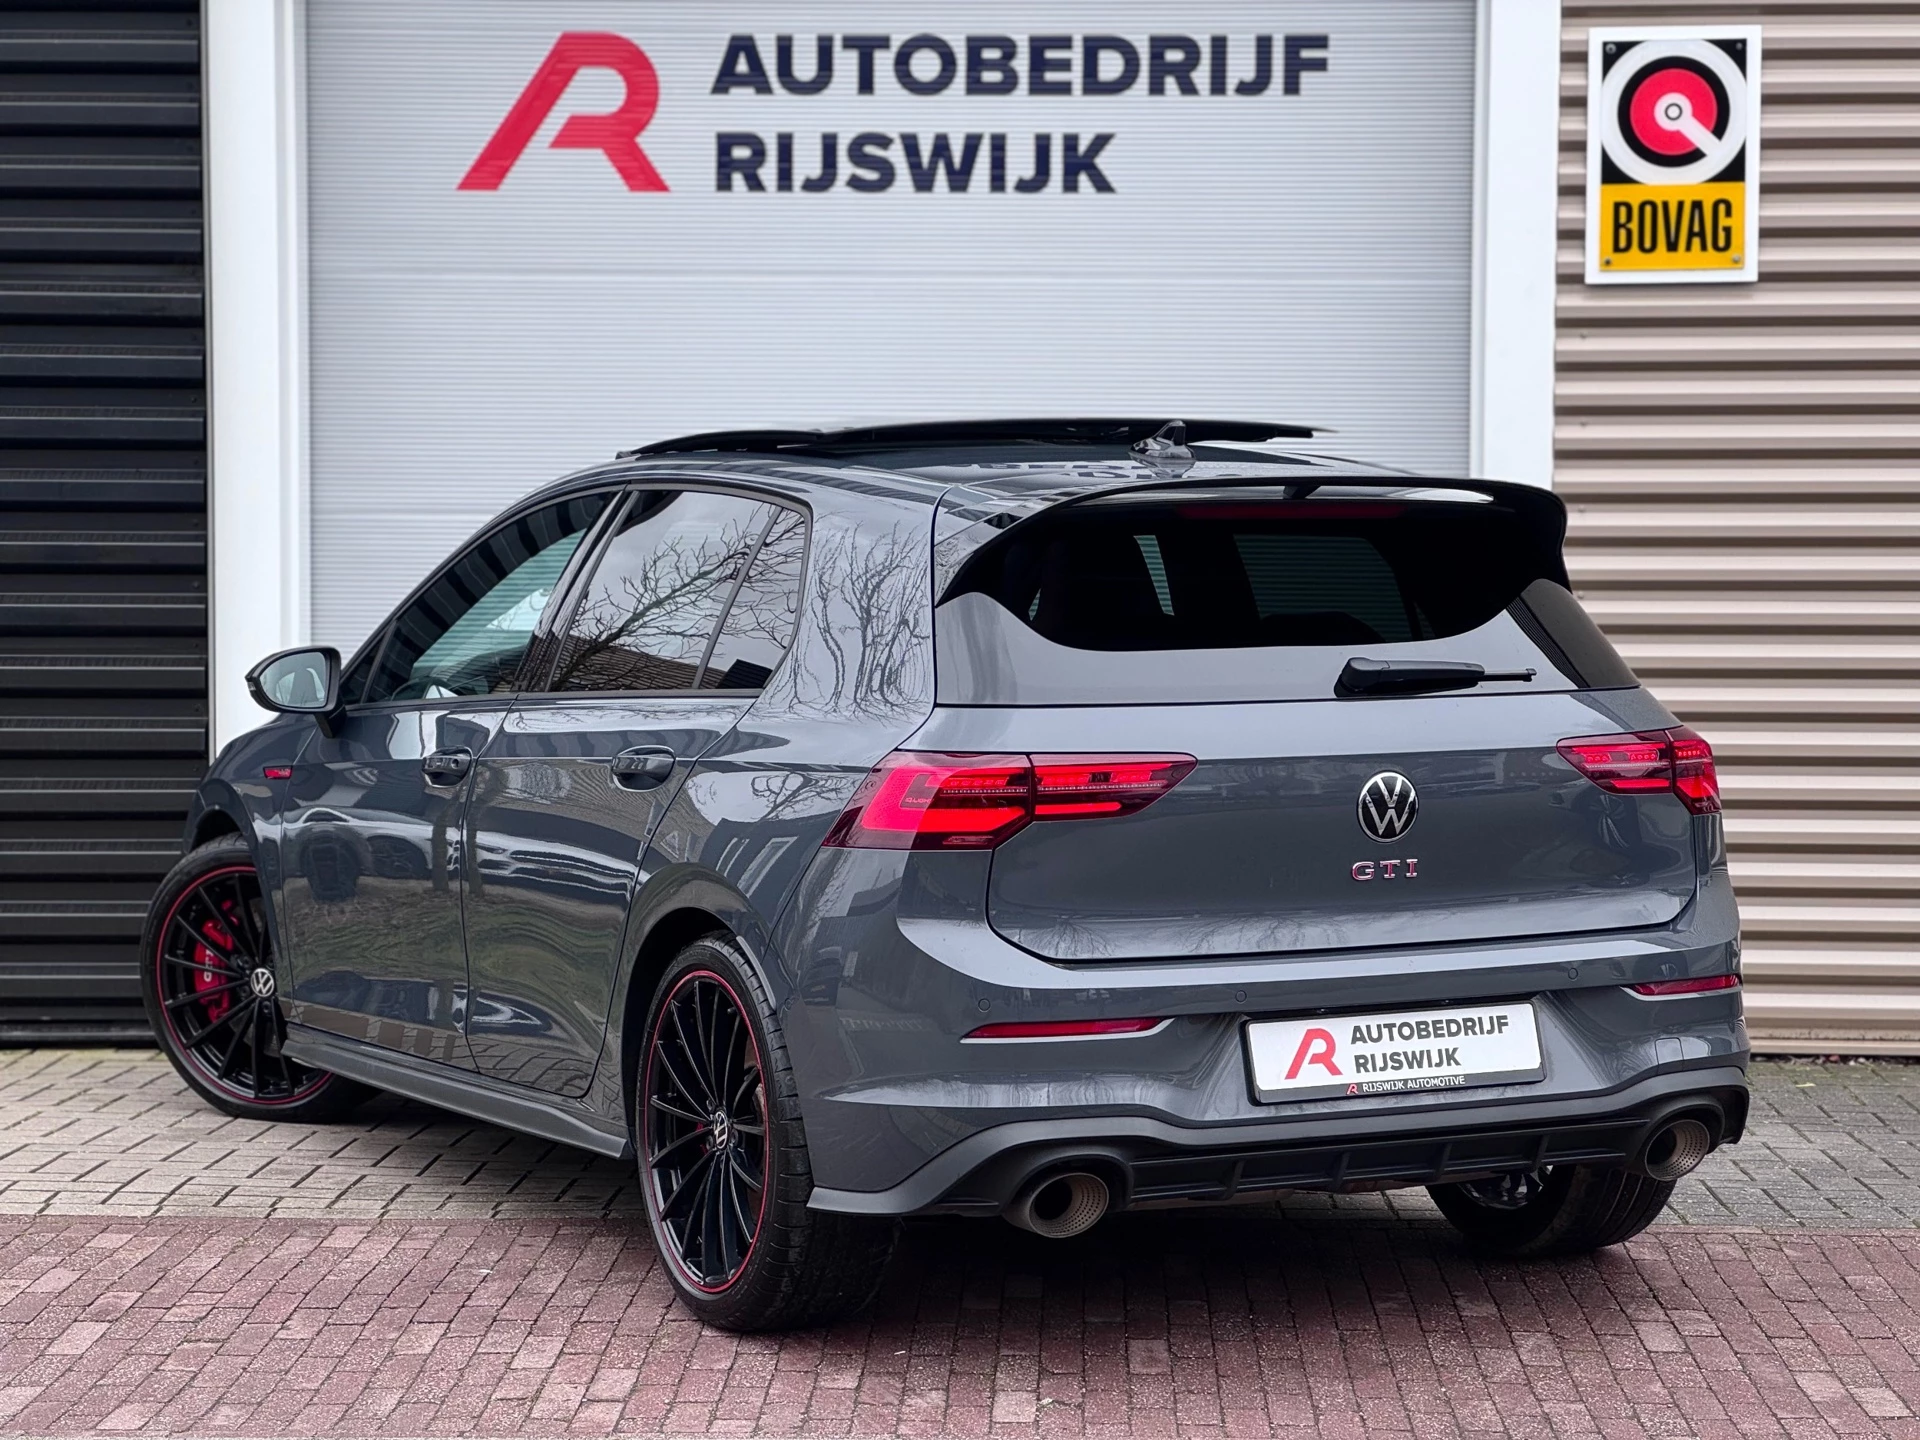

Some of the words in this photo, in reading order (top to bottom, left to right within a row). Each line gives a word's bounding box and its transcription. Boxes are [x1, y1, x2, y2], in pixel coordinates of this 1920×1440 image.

[710, 33, 1330, 97] AUTOBEDRIJF
[715, 132, 1117, 194] RIJSWIJK
[1612, 198, 1733, 255] BOVAG
[1351, 858, 1419, 881] GTI
[1350, 1015, 1509, 1045] AUTOBEDRIJF
[1353, 1047, 1462, 1074] RIJSWIJK
[1362, 1079, 1406, 1093] RIJSWIJK
[1407, 1075, 1466, 1089] AUTOMOTIVE
